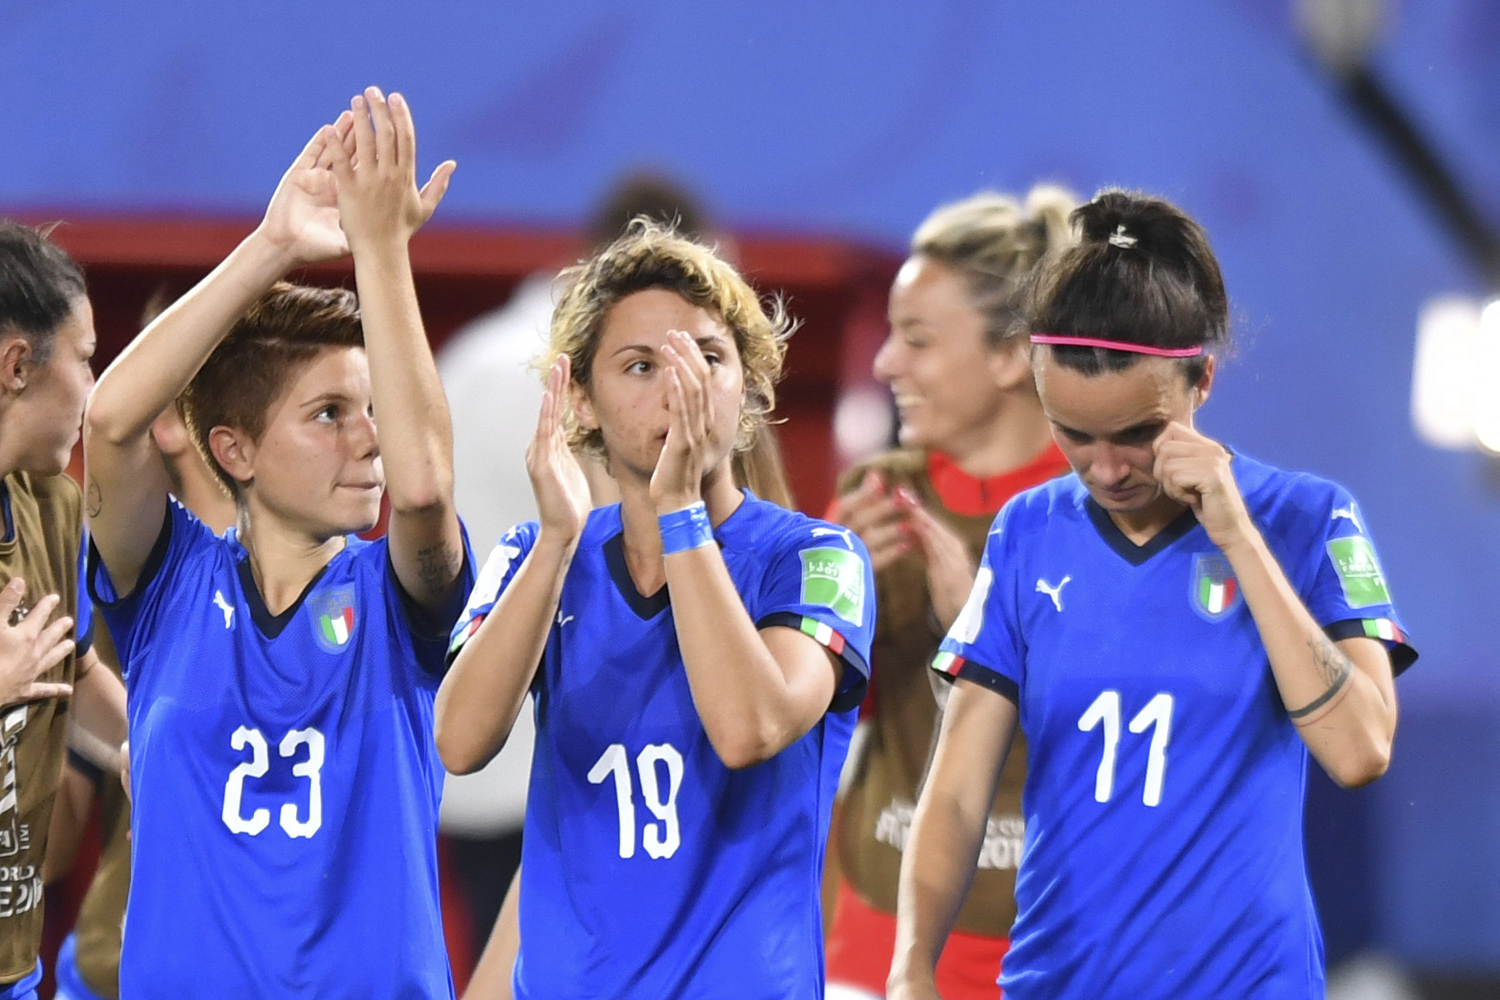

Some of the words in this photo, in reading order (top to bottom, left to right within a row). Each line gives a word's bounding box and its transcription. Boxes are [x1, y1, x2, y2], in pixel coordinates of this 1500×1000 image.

[222, 725, 326, 839] 23
[588, 743, 685, 860] 19
[1078, 690, 1174, 807] 11
